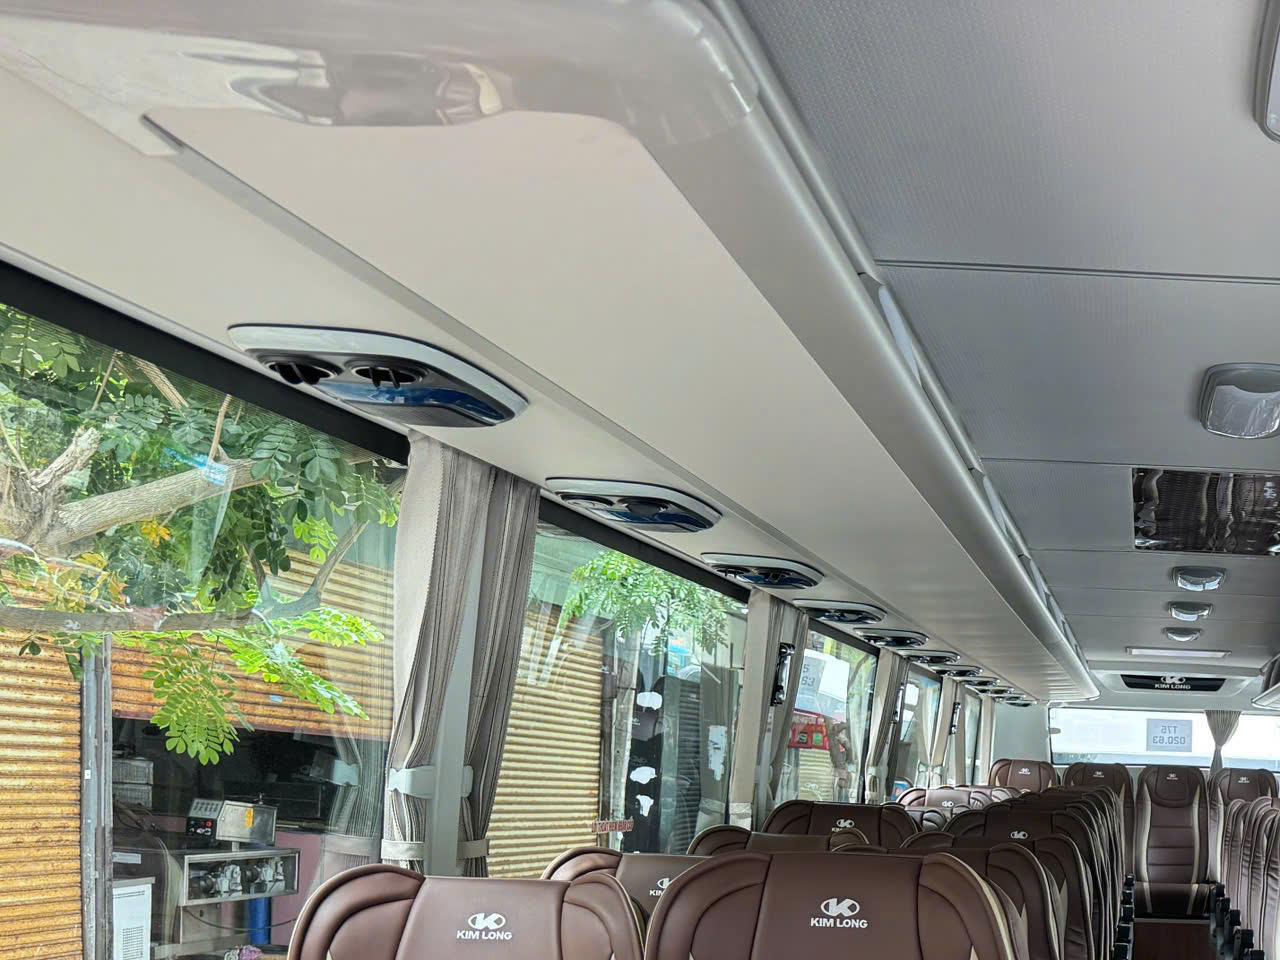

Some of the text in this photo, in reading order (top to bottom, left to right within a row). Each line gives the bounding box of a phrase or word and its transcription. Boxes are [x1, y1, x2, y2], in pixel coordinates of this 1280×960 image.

[810, 917, 869, 929] KIM LONG
[456, 930, 513, 941] KIM LONG
